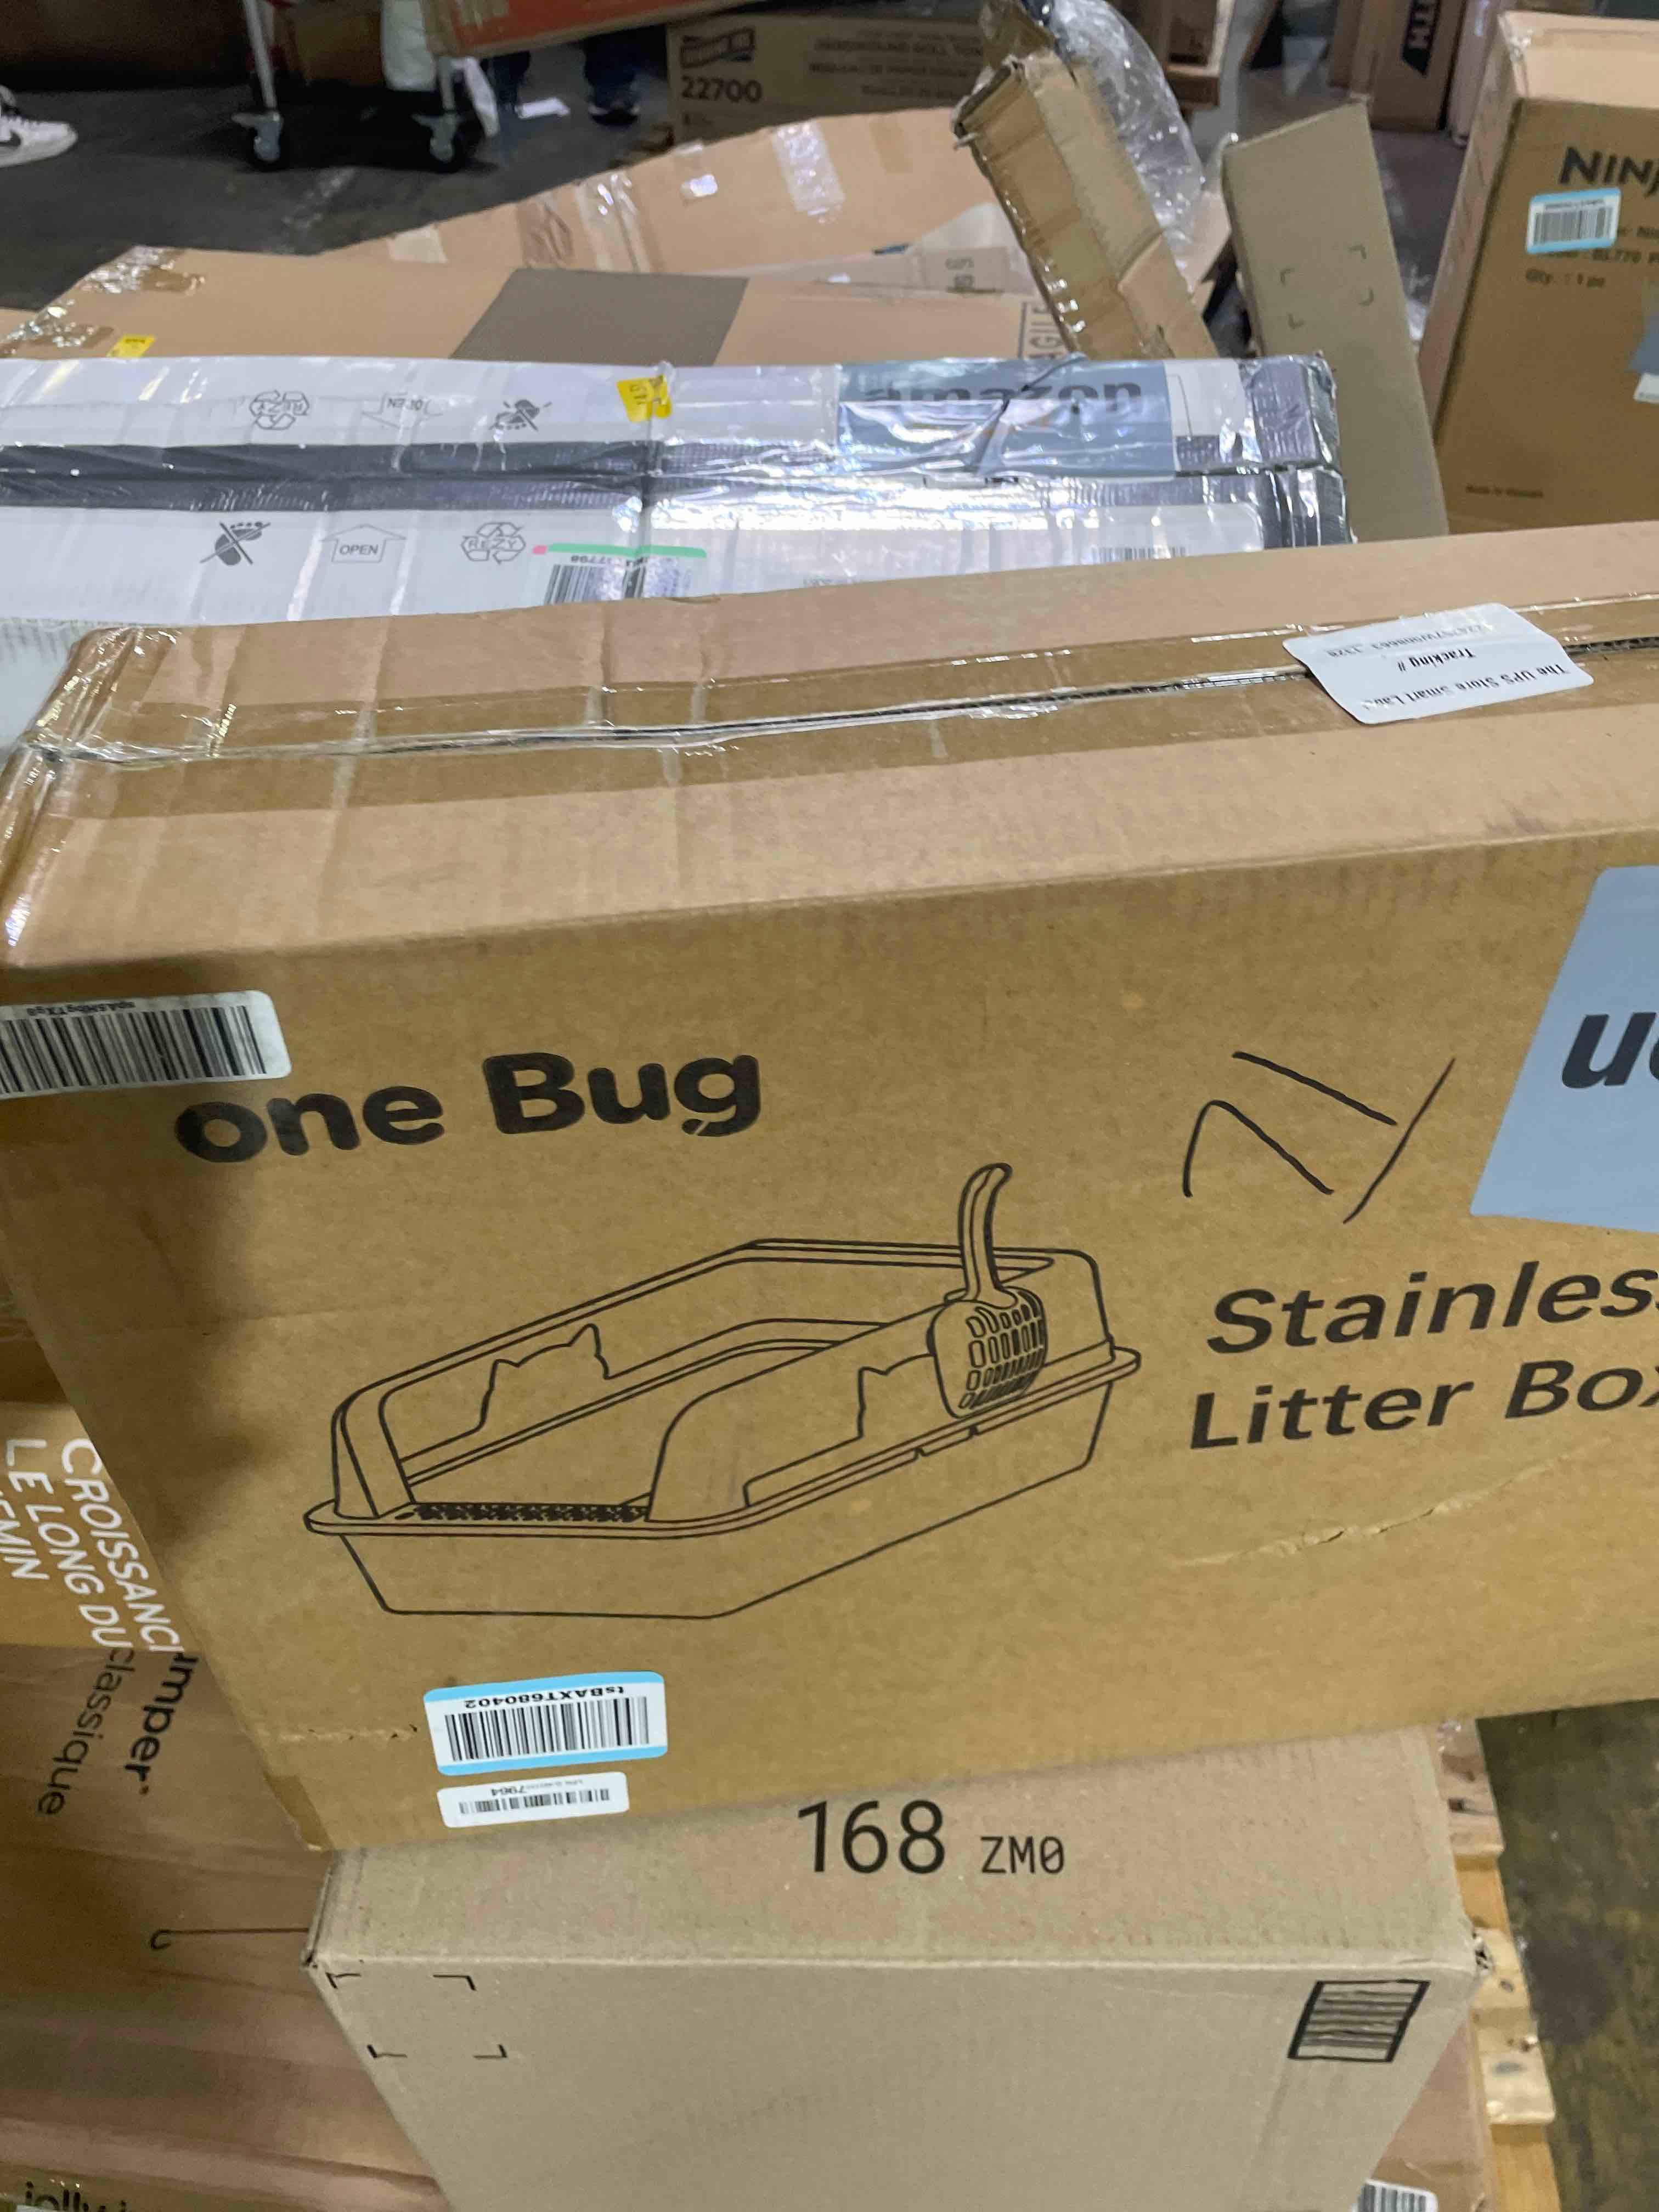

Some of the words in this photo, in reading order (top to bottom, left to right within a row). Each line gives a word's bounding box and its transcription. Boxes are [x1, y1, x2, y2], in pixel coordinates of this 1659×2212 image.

[681, 76, 763, 103] 22700
[339, 544, 379, 556] OPEN
[1502, 669, 1534, 686] UPS
[1537, 663, 1570, 676] The
[175, 1085, 445, 1163] one
[482, 1052, 761, 1137] Bug
[1207, 1260, 1659, 1353] Stainles
[1190, 1381, 1475, 1449] Litter
[25, 1504, 105, 1595] LONG
[78, 1604, 134, 1647] DU
[798, 1799, 946, 1874] 168
